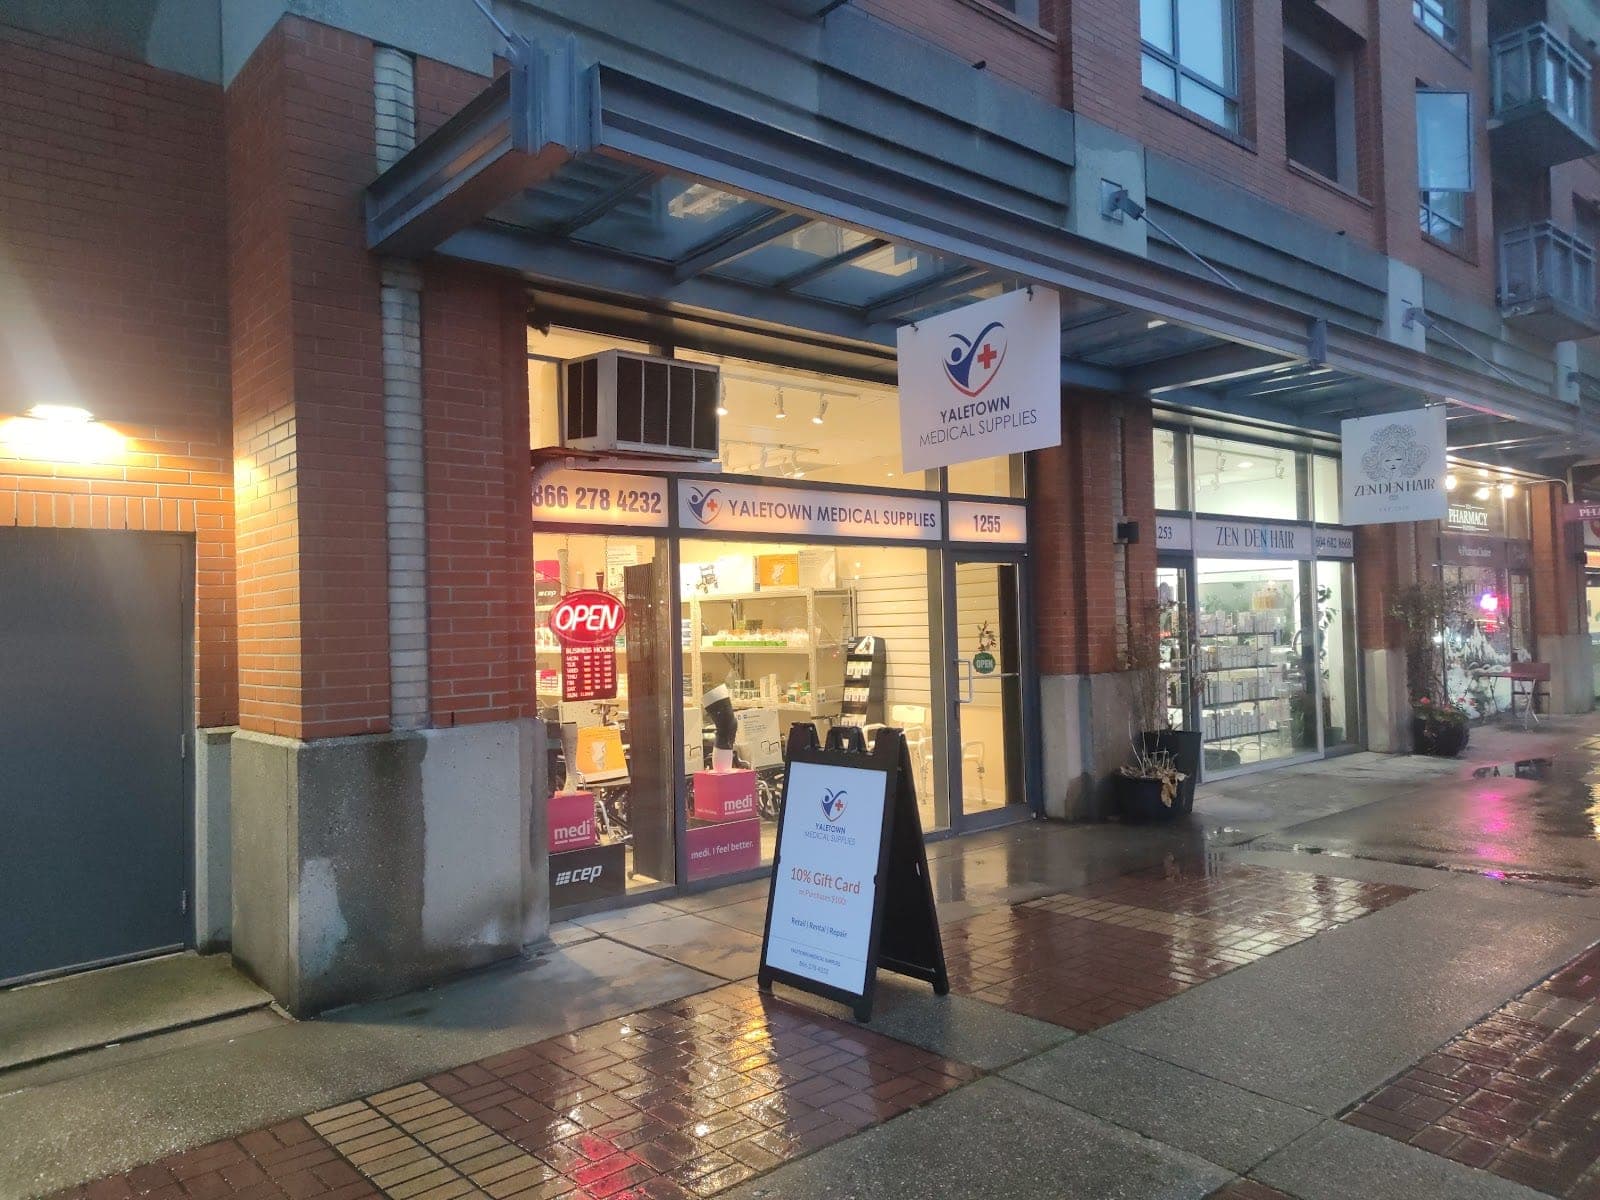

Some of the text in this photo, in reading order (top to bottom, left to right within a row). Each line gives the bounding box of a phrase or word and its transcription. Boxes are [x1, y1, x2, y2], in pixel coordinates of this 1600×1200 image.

[940, 395, 1010, 424] YALETOWN
[919, 409, 1037, 448] MEDICAL SUPPLIES
[1354, 478, 1436, 497] ZEN DEN HAIR
[532, 484, 662, 514] 866 278 4232
[728, 499, 936, 528] YALETOWN MEDICAL SUPPLIES
[1447, 508, 1488, 526] PHARMACY
[972, 514, 1001, 534] 1255
[1215, 526, 1295, 549] ZEN DEN HAIR
[555, 604, 620, 631] OPEN
[976, 659, 993, 669] OPEN
[724, 793, 753, 811] medi
[553, 819, 591, 840] medi
[804, 830, 856, 846] MEDICAL SUPPLIES
[815, 822, 846, 834] YALETOWN
[690, 848, 711, 860] medi.
[715, 843, 730, 854] feel
[731, 840, 754, 850] better.
[571, 865, 603, 883] cep
[791, 867, 861, 894] 10% Gift Card
[791, 916, 848, 938] Retail Rental Repair
